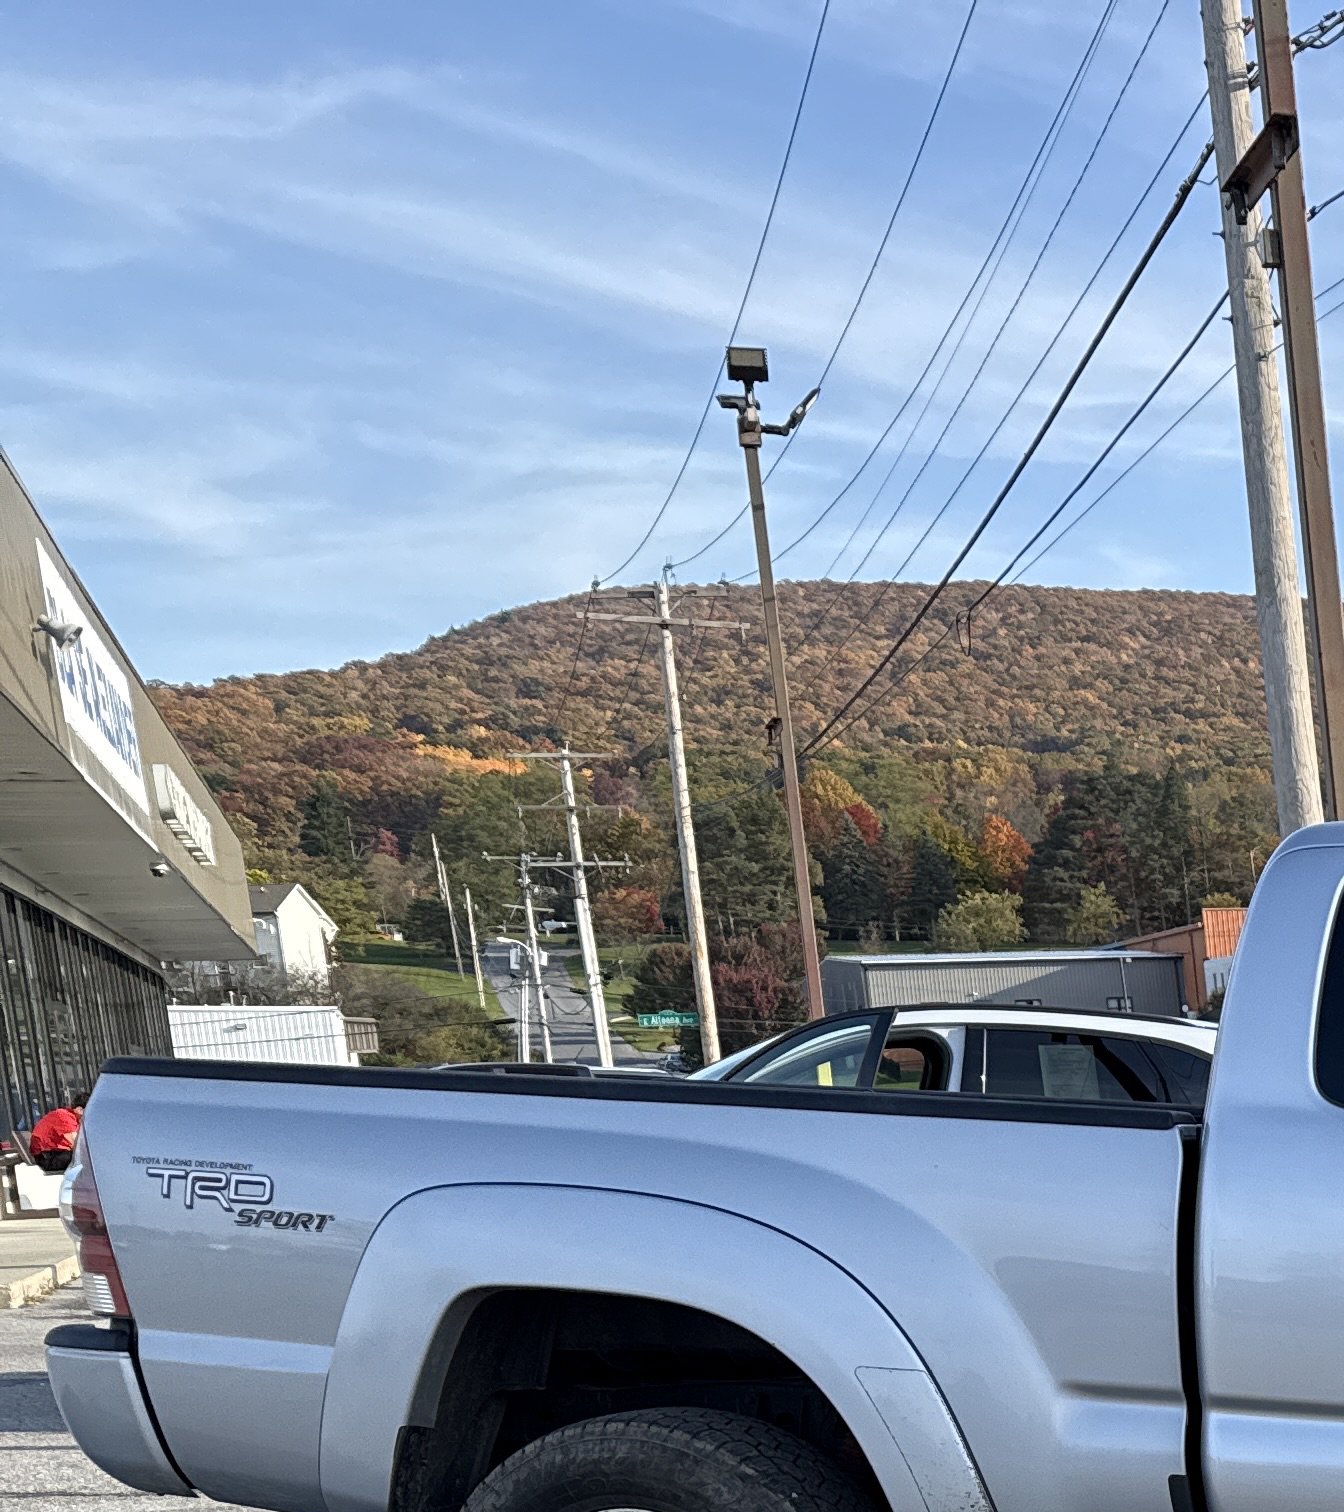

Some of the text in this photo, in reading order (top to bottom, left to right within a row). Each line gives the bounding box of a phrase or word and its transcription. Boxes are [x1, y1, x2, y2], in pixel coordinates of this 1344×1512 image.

[132, 1156, 254, 1171] TOYOTA RACING DEVELOPMENT
[146, 1167, 274, 1212] TRD
[234, 1208, 330, 1232] SPORT
